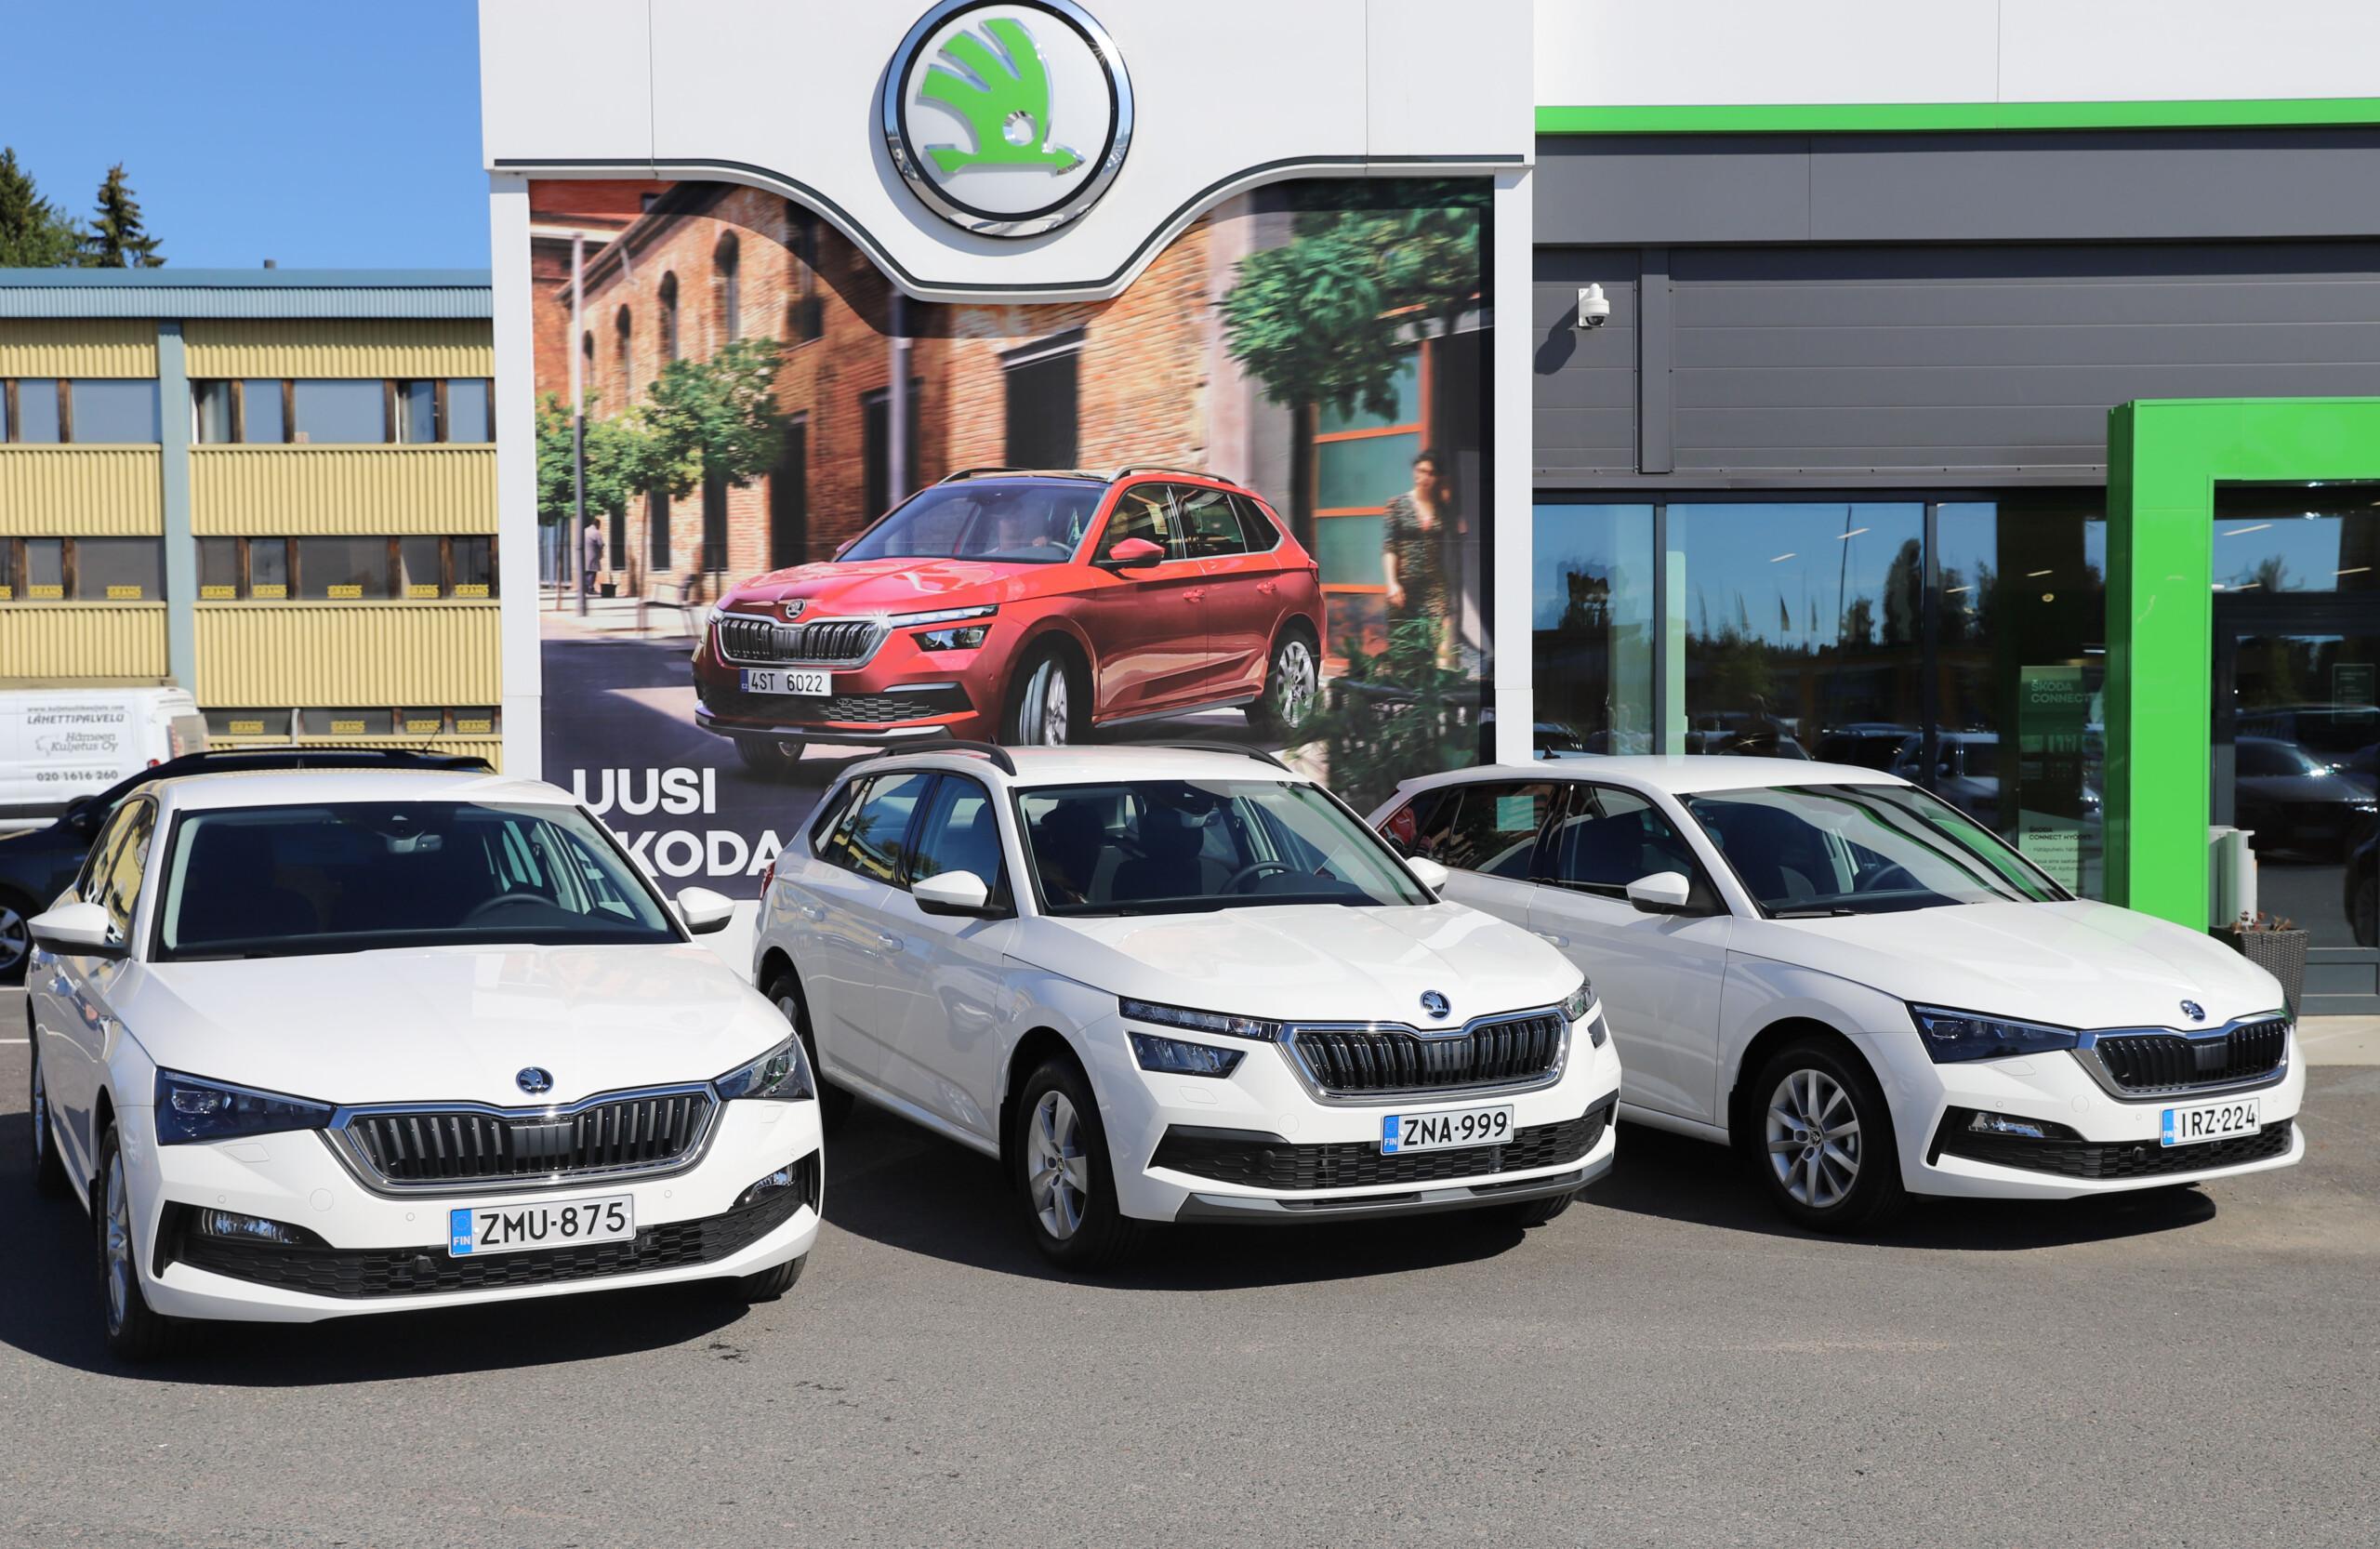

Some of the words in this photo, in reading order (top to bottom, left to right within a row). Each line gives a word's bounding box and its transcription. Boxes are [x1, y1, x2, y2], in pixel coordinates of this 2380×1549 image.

[751, 672, 774, 690] 4ST
[787, 674, 822, 692] 6022
[2031, 679, 2072, 692] ŠKODA
[2031, 693, 2091, 703] CONNECT
[27, 713, 125, 724] LÄHETTIPALVELU
[66, 732, 115, 742] Hämeen
[51, 741, 99, 753] Kuljetus
[101, 741, 118, 752] Oy
[36, 773, 59, 781] 020
[63, 772, 92, 781] 1616
[96, 770, 118, 780] 260
[573, 767, 716, 815] UUSI
[614, 828, 784, 877] KODA
[1384, 1137, 1397, 1146] FIN
[1404, 1112, 1508, 1145] ZNA-999
[2182, 1105, 2255, 1138] IRZ-224
[454, 1235, 471, 1247] FIN
[480, 1202, 626, 1246] ZMU-875
